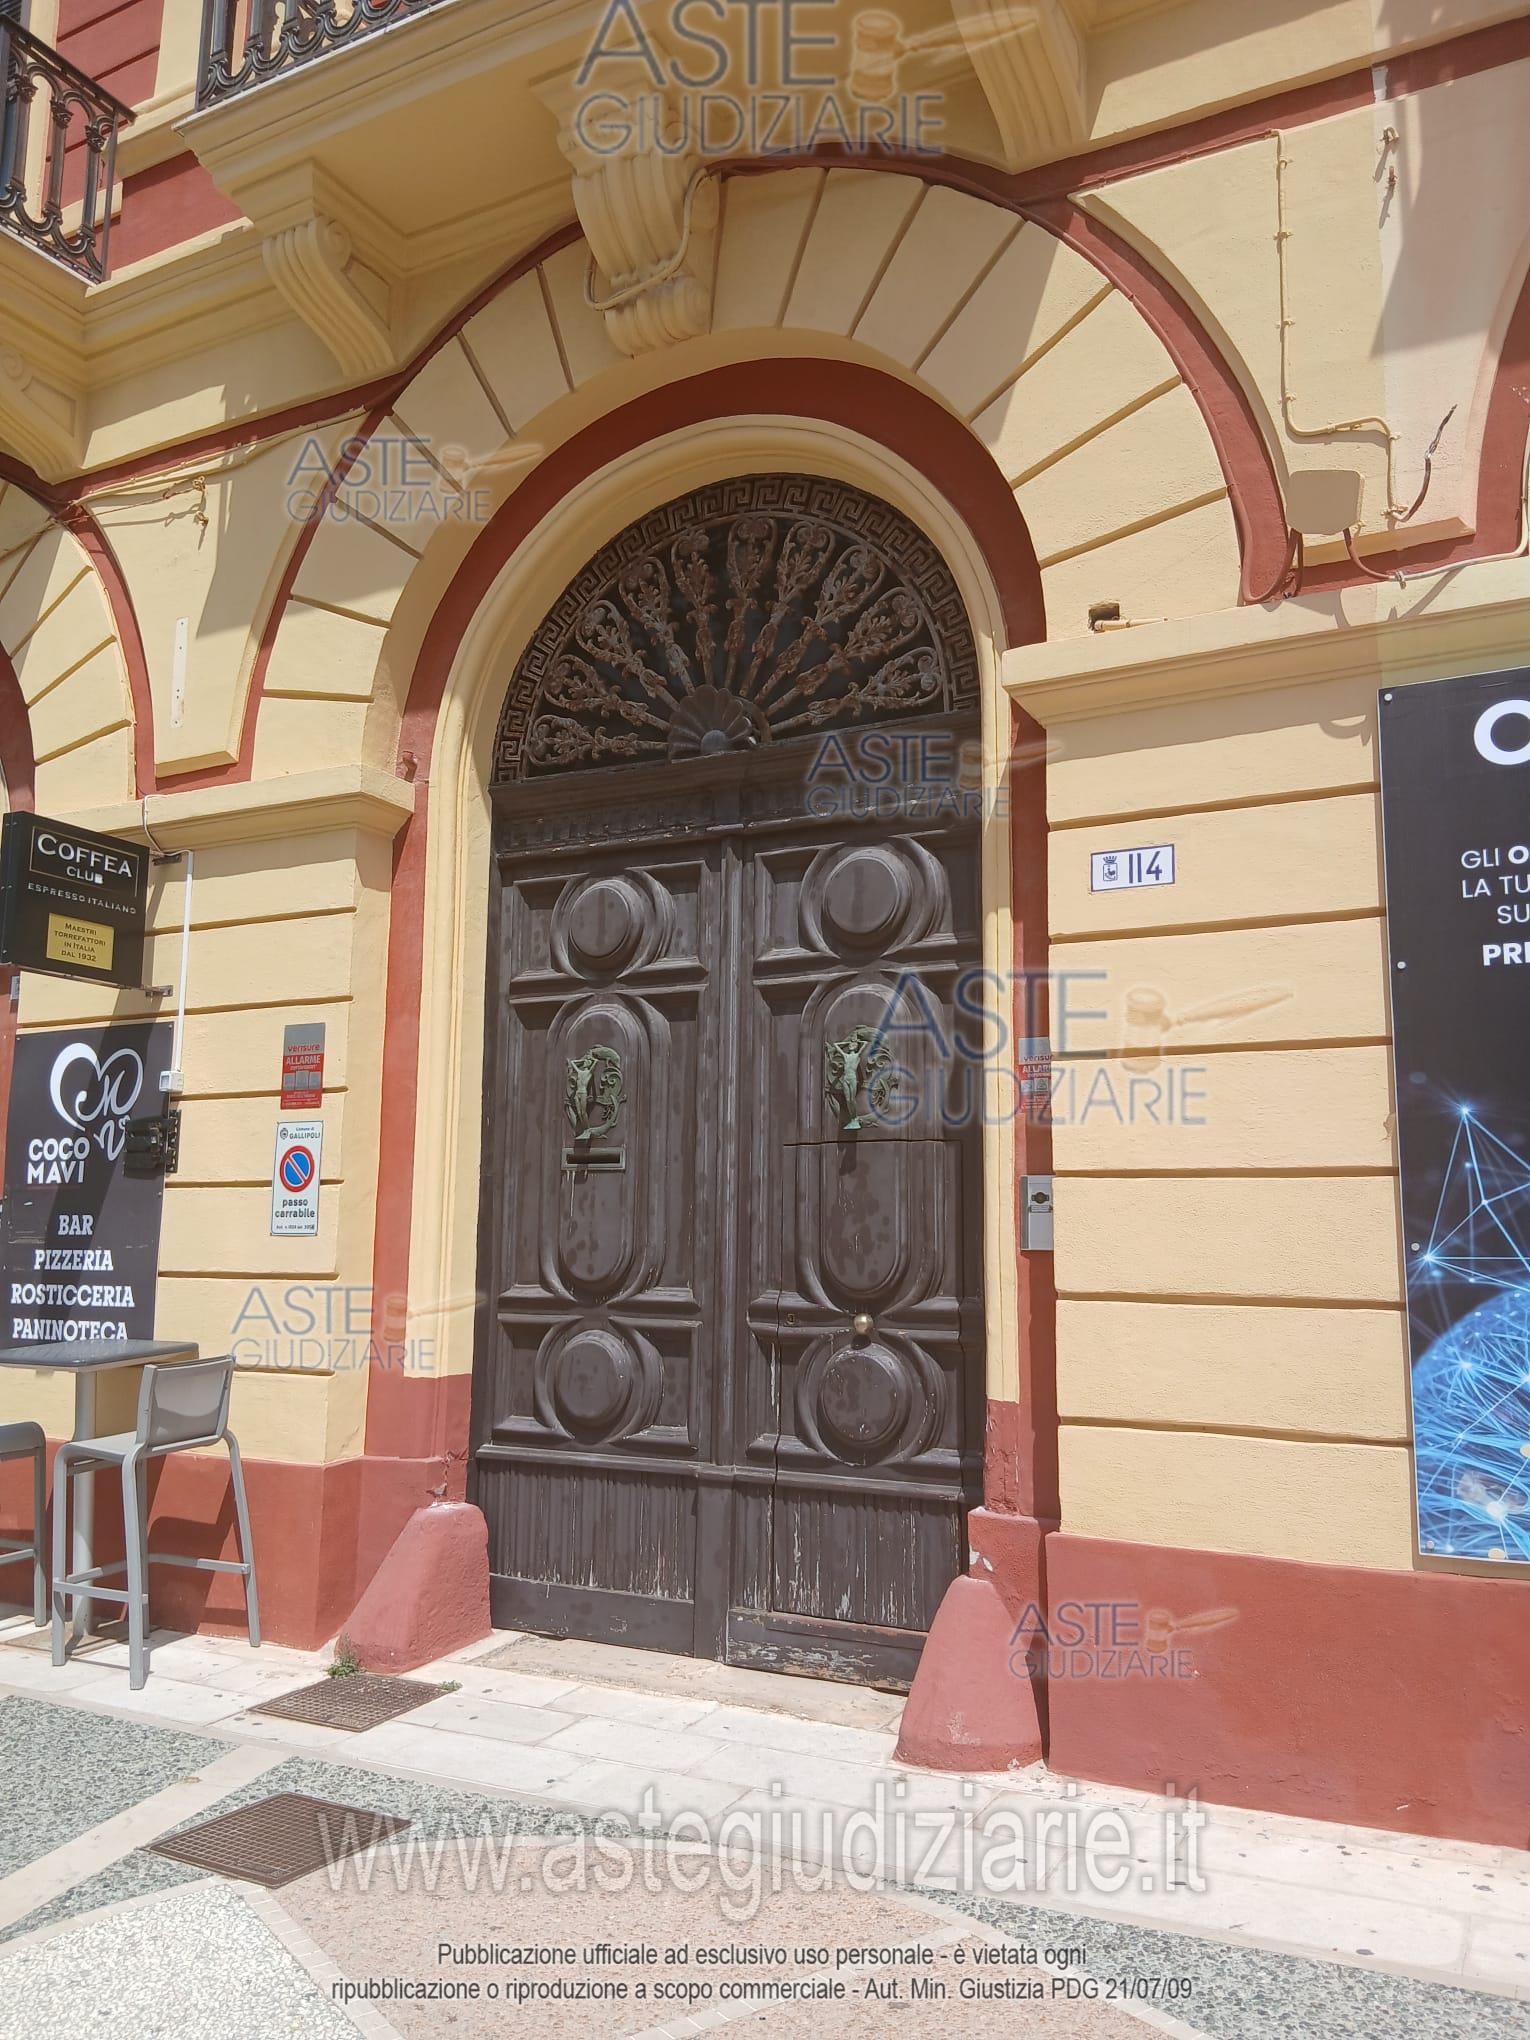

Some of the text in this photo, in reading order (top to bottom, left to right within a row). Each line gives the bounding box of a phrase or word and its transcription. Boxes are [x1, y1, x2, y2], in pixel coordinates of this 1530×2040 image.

[37, 833, 133, 878] COFFEA
[1461, 847, 1500, 869] GLI
[66, 865, 104, 885] CLUB
[1128, 850, 1163, 884] 114
[28, 882, 137, 915] ESPRESSO ITALIANO
[1462, 878, 1492, 899] LA
[54, 929, 106, 946] TORREFATTORI
[78, 952, 97, 962] 1932
[286, 1054, 321, 1066] ALLARME
[289, 1131, 320, 1140] GALLIPOLI
[28, 1136, 90, 1162] COCO
[27, 1160, 85, 1184] MAVI
[275, 1207, 315, 1218] carrabile
[282, 1199, 308, 1209] passo
[58, 1214, 94, 1236] BAR
[34, 1249, 114, 1271] PIZZERIA
[11, 1283, 136, 1308] ROSTICCERIA
[12, 1317, 128, 1342] PANINOTECA
